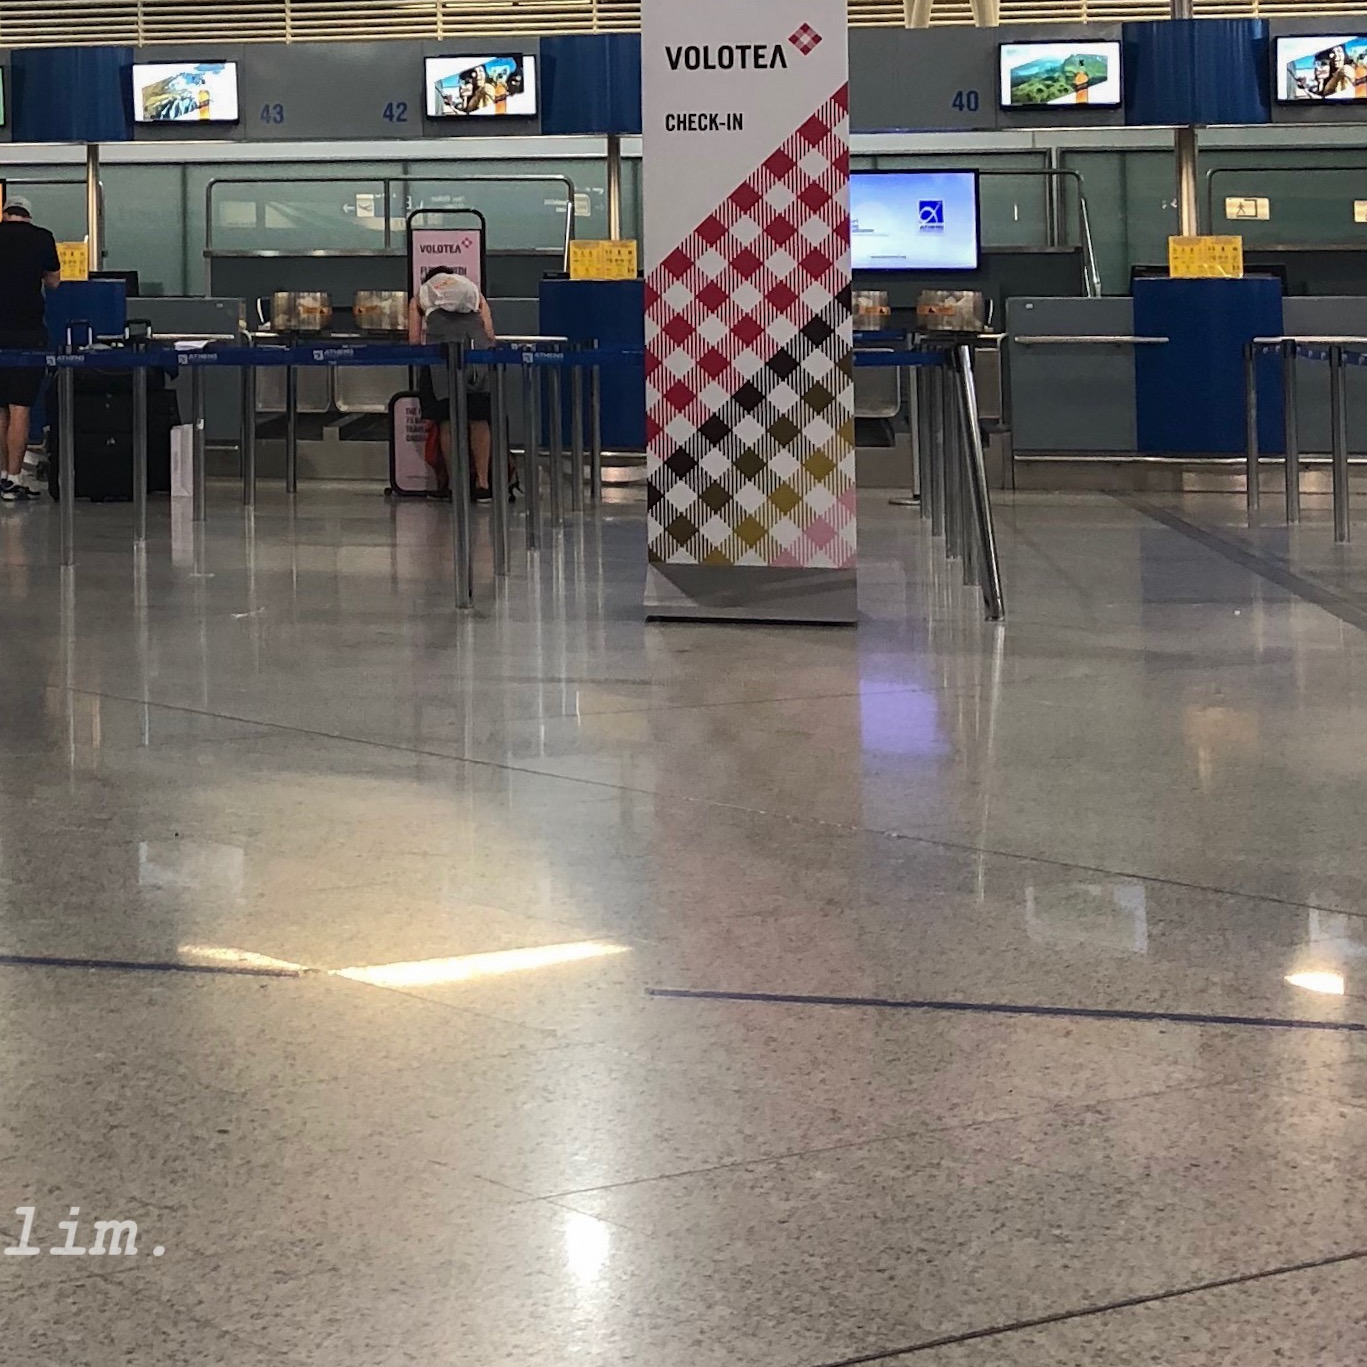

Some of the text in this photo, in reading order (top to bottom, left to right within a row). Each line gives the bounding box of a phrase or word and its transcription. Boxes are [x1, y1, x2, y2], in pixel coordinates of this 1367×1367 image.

[665, 44, 788, 70] VOLOTEA
[951, 90, 979, 112] 40
[260, 103, 285, 124] 43
[382, 102, 408, 123] 42
[664, 113, 744, 132] CHECK-IN
[419, 244, 462, 254] VOLOTEA
